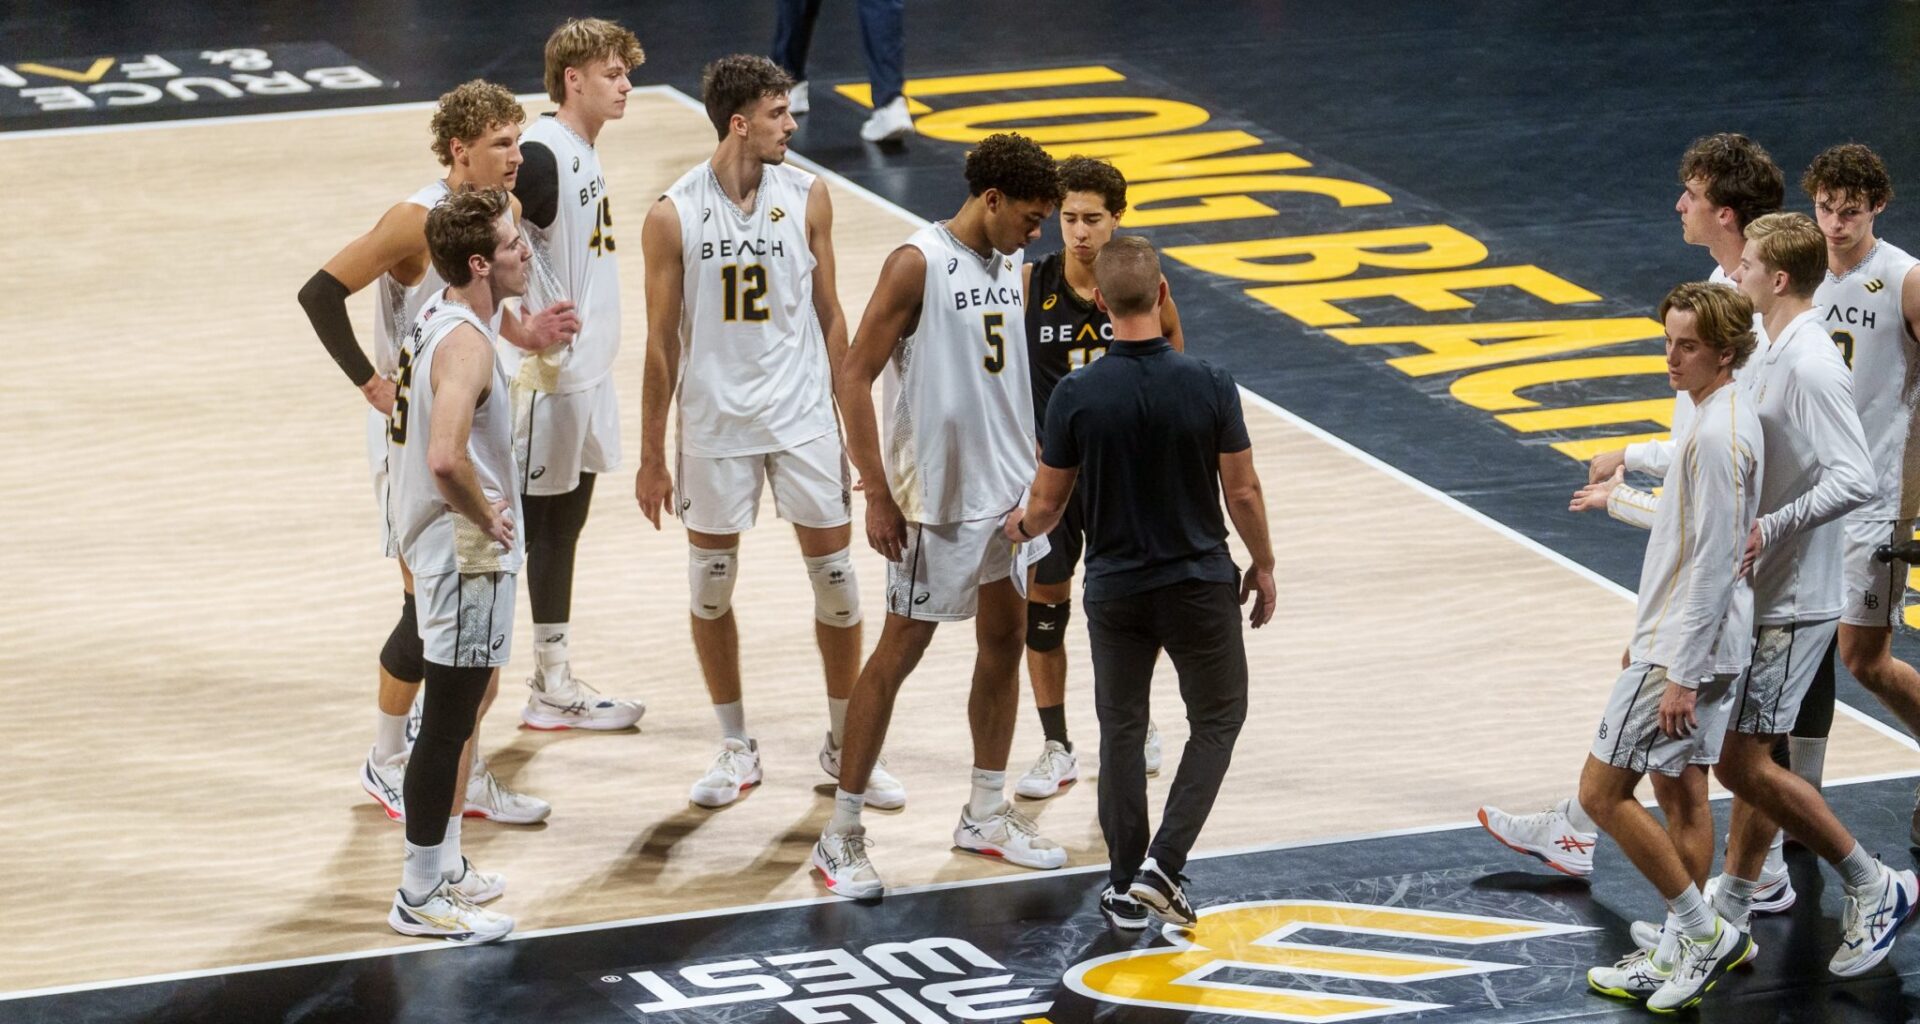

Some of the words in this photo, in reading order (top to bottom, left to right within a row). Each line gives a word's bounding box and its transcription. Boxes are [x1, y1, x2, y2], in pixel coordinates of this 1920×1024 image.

[200, 47, 273, 71] &
[20, 66, 383, 110] BRUCE
[834, 65, 1392, 228] LONG
[579, 175, 606, 207] BEA
[701, 238, 784, 260] BEACH
[720, 263, 770, 322] 12
[954, 287, 1022, 311] BEACH
[982, 312, 1005, 374] 5
[1040, 323, 1114, 343] BEAC
[627, 937, 1007, 1013] WEST
[777, 974, 1055, 1024] BIG
